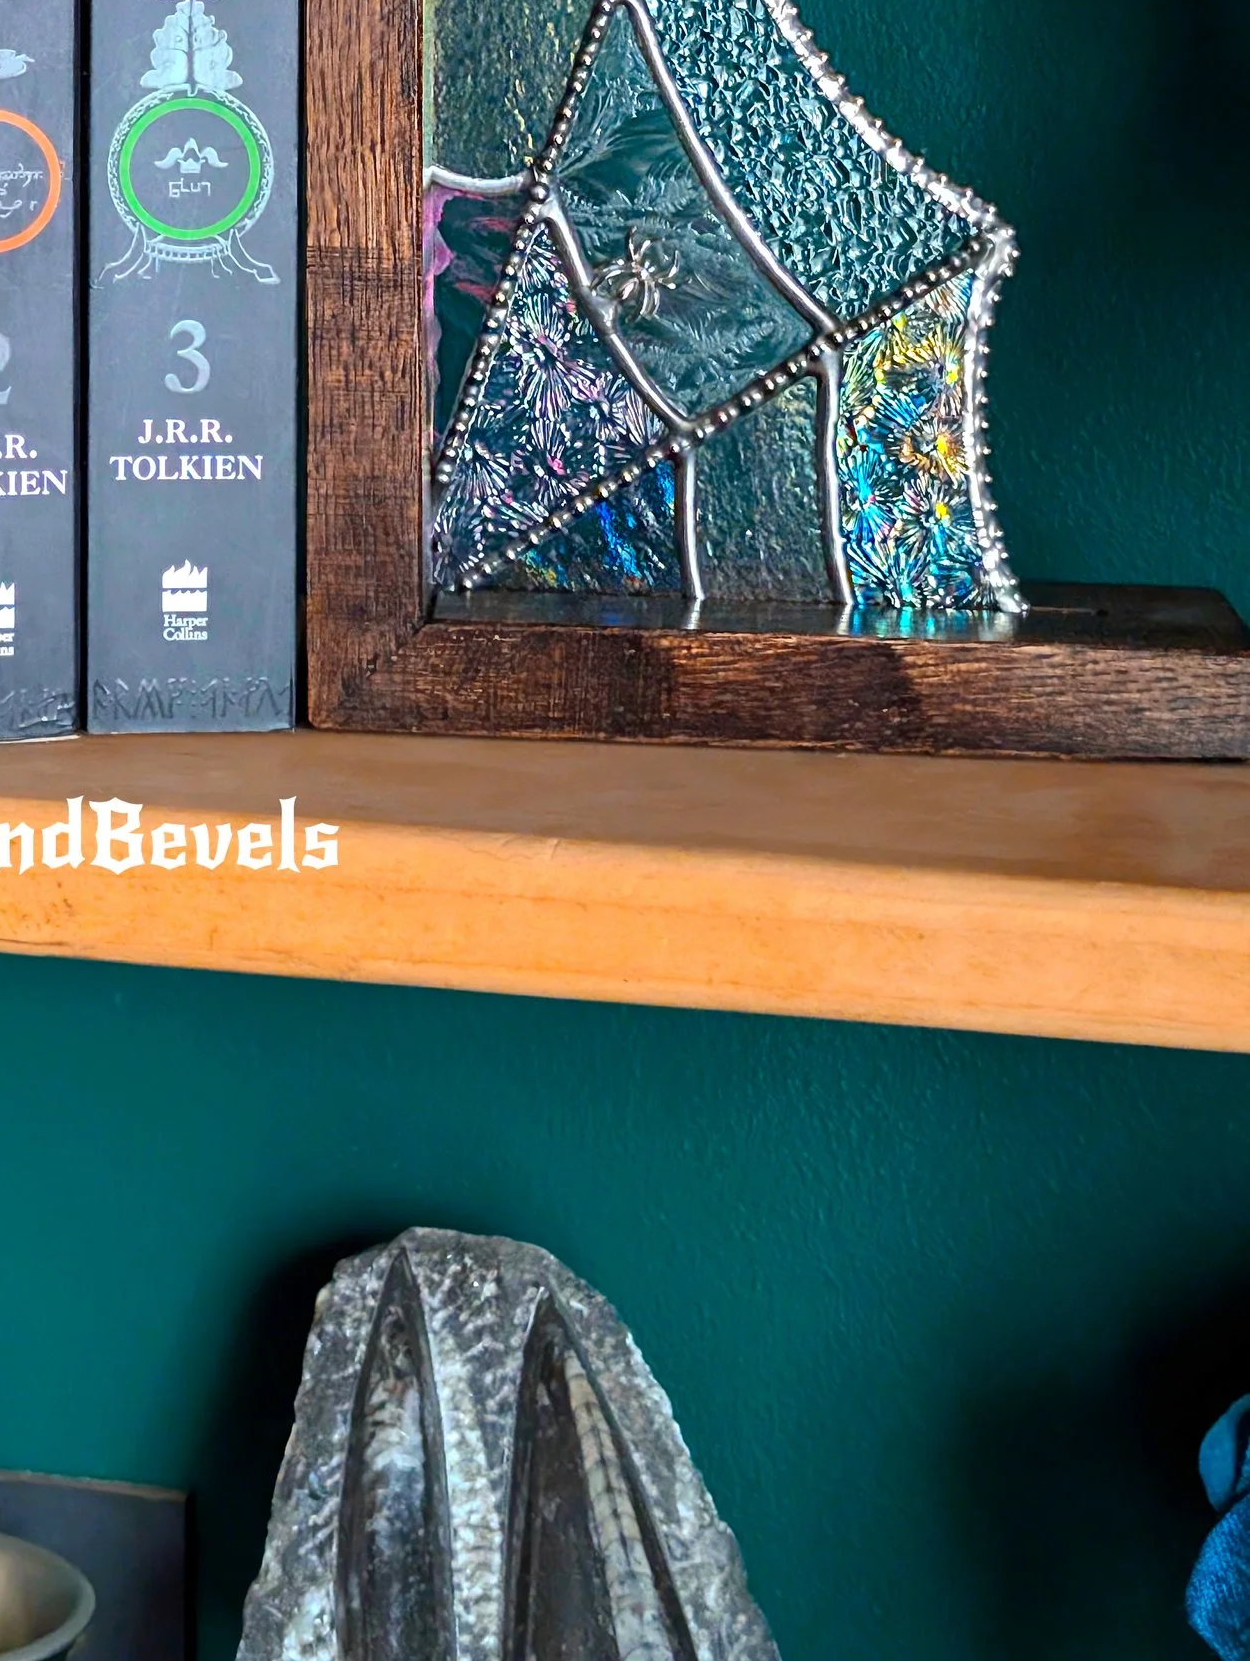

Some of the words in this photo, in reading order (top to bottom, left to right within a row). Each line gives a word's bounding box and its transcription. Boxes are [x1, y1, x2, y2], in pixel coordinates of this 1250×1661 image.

[164, 319, 211, 395] 3
[137, 418, 233, 445] J.R.R.
[109, 454, 264, 482] TOLKIEN
[162, 626, 208, 641] Collins
[163, 613, 209, 629] Harper
